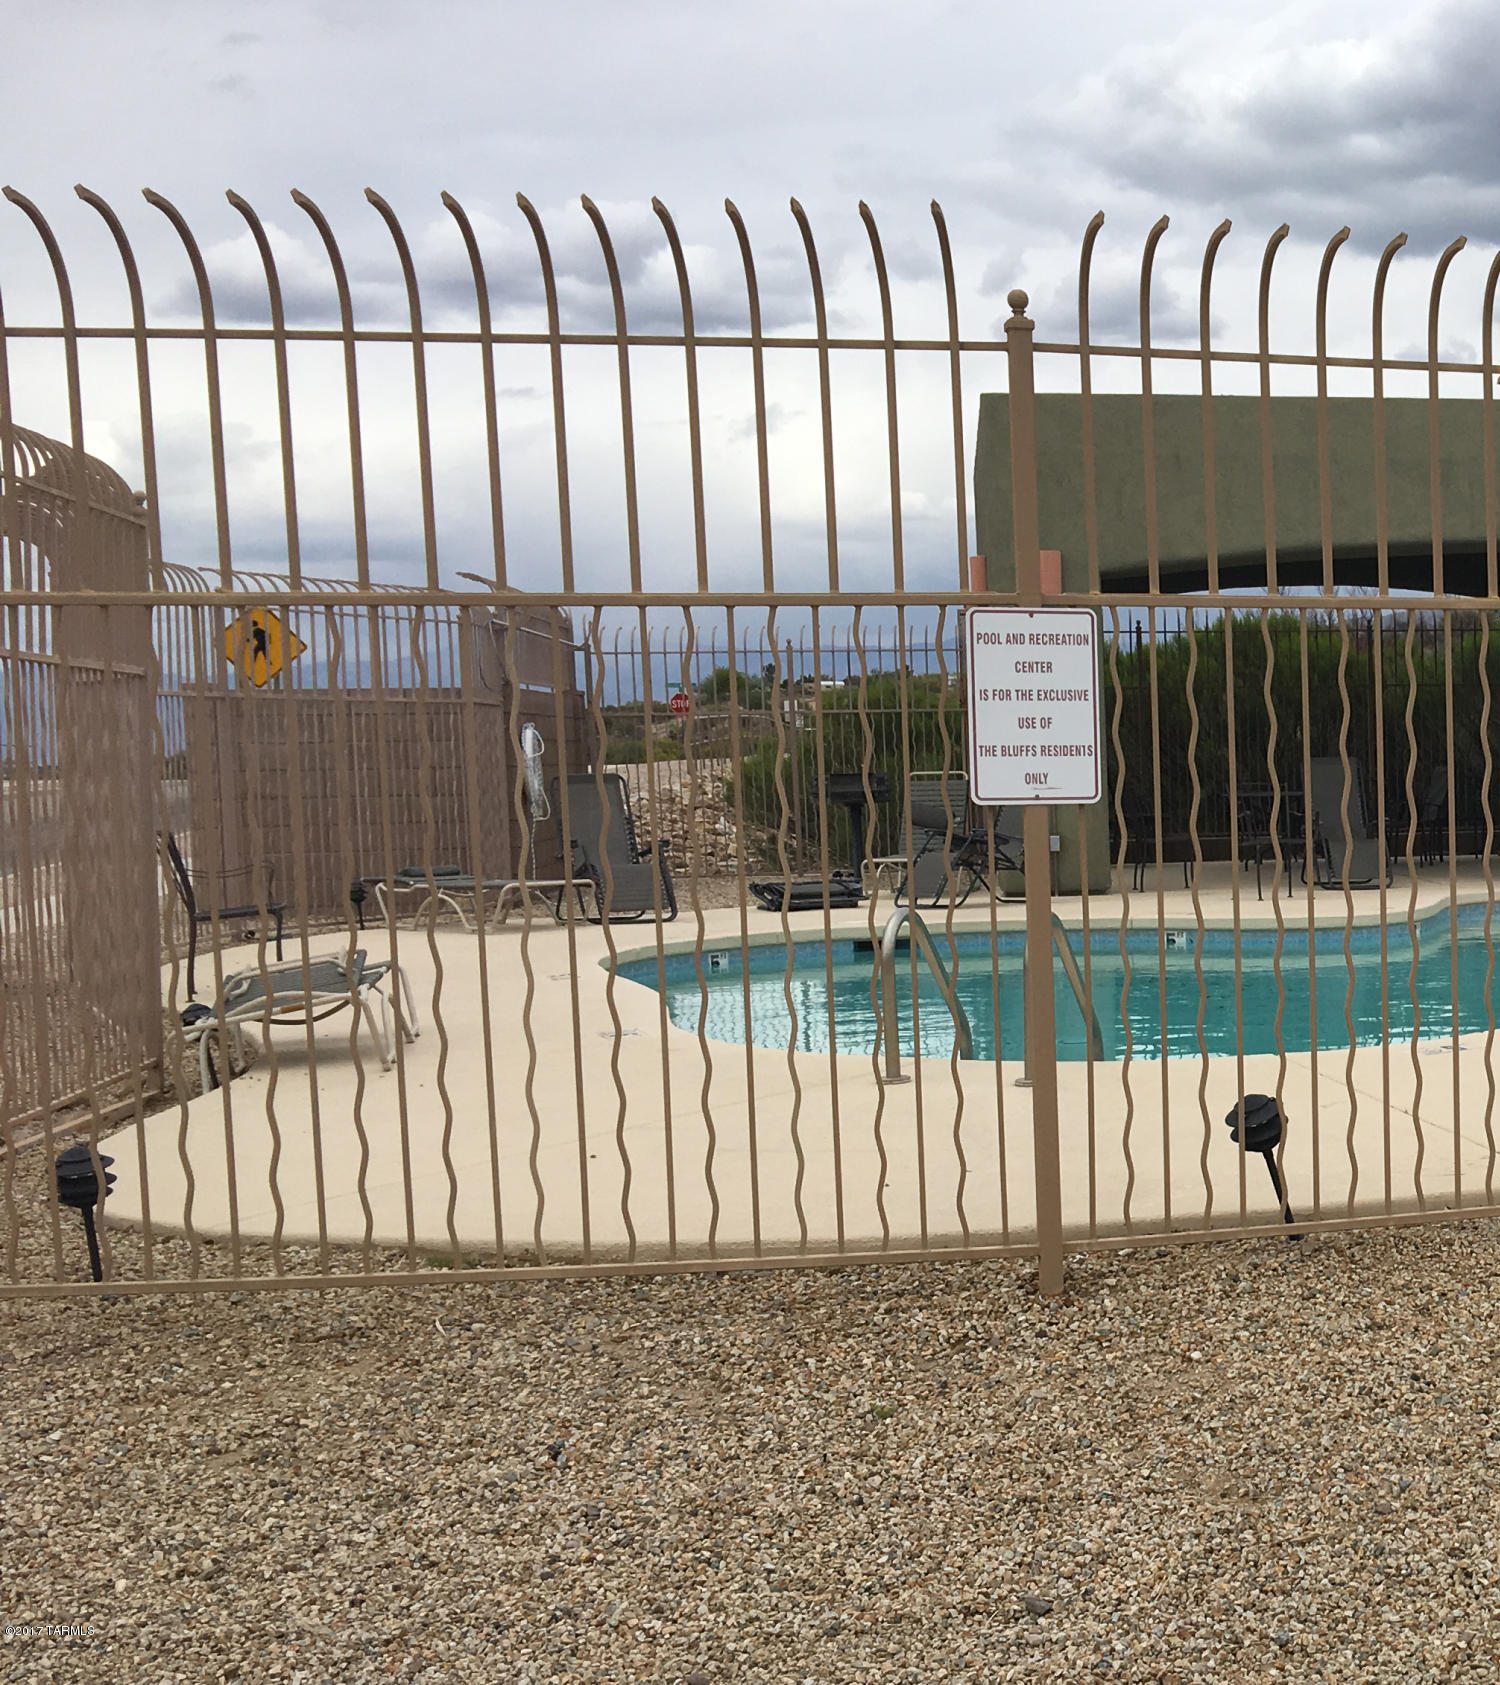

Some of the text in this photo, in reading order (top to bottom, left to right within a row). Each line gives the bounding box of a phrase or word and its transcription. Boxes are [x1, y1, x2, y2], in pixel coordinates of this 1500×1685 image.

[976, 633, 1089, 646] POOL AND RECREATION
[1015, 661, 1053, 673] CENTER
[979, 689, 1089, 702] IS FOR THE EXCLUSIVE
[1018, 717, 1053, 729] USE OF
[978, 744, 1094, 757] THE BLUFFS RESIDENTS
[1024, 772, 1049, 785] ONLY
